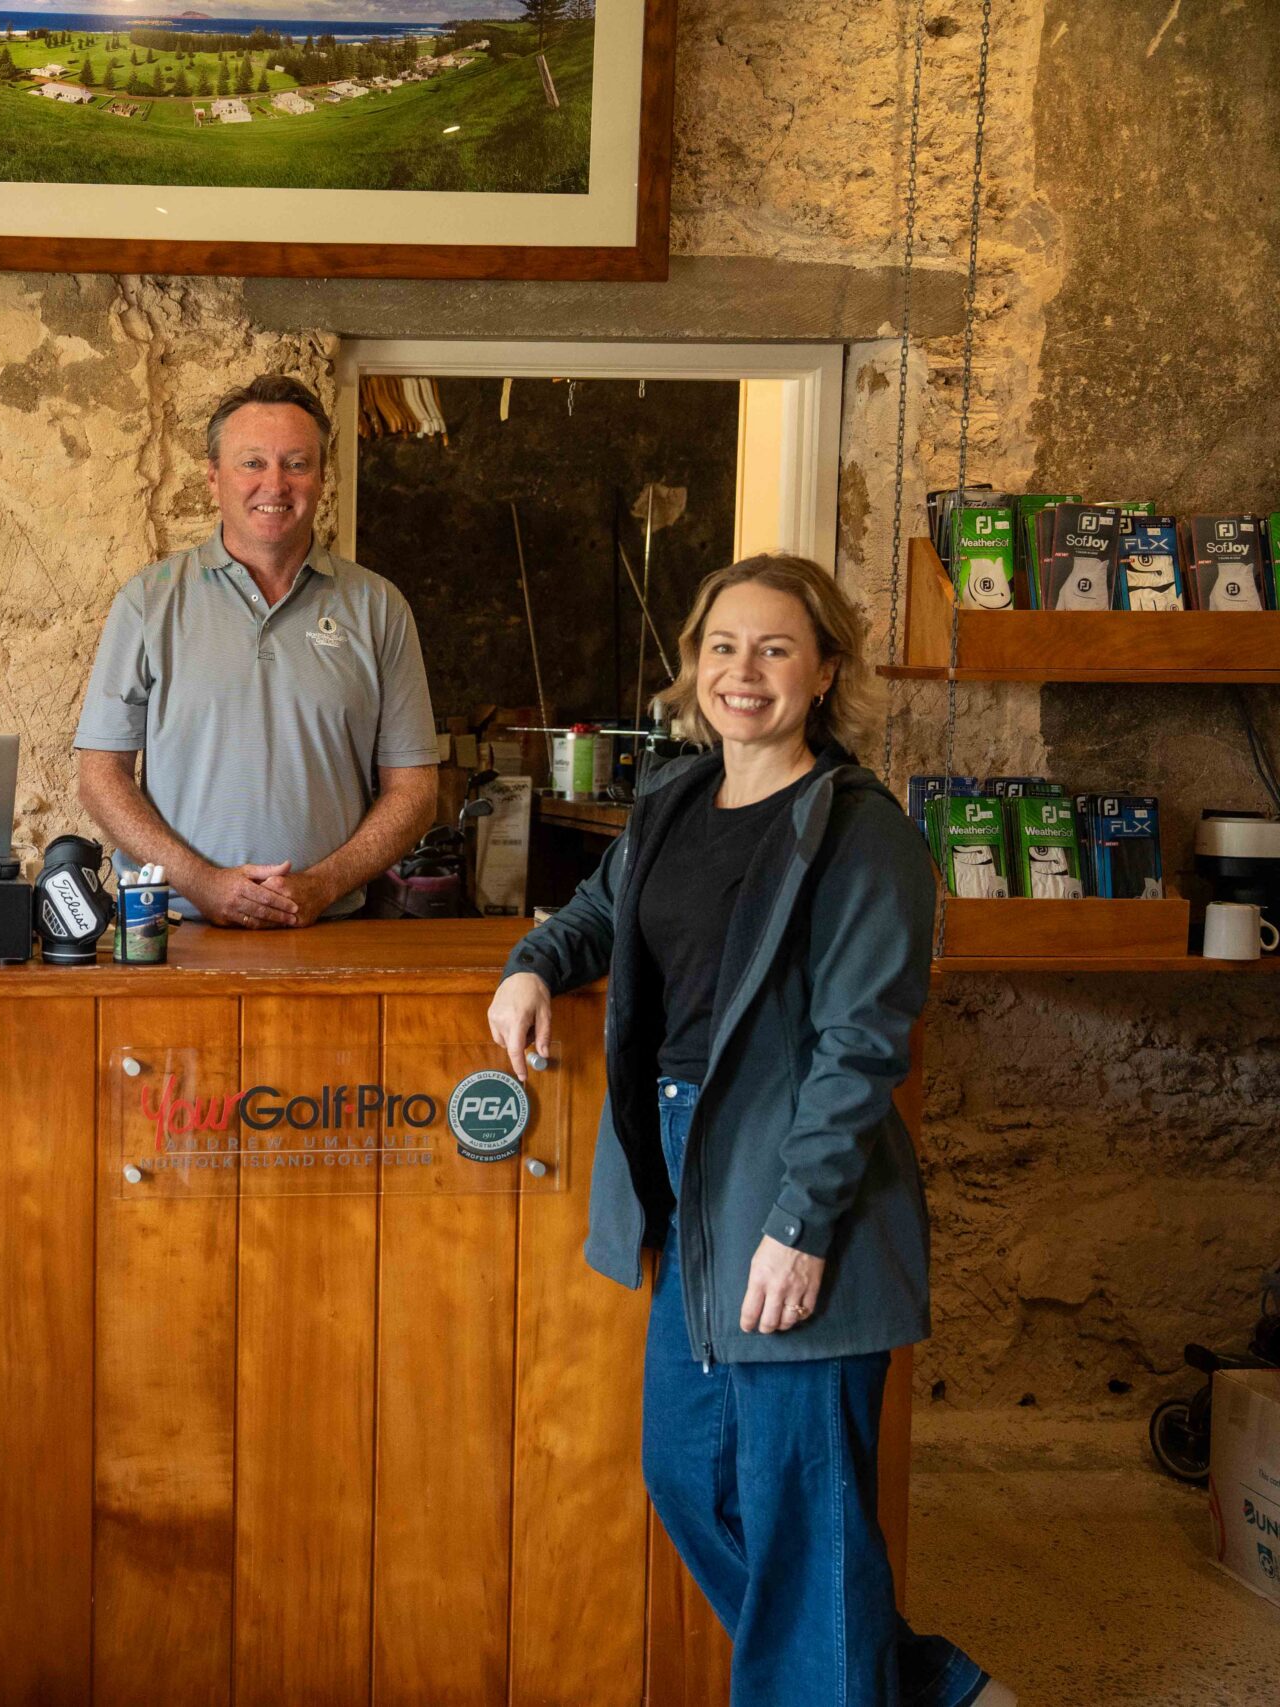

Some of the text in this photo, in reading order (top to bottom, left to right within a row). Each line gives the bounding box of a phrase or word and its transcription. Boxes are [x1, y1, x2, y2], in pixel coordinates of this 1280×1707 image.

[975, 515, 992, 535] FJ
[1081, 515, 1097, 531] FJ
[1218, 523, 1234, 537] FJ
[1065, 534, 1110, 551] SofJoy
[1124, 538, 1169, 550] FLX
[1206, 542, 1250, 555] SofJoy
[982, 580, 992, 589] FJ
[1079, 580, 1090, 591] FJ
[1227, 584, 1239, 594] FJ
[965, 803, 982, 823] FJ
[1041, 805, 1058, 824] FJ
[1103, 798, 1119, 816] FJ
[949, 825, 999, 836] WeatherSof
[1025, 826, 1074, 838] WeatherSof
[1110, 820, 1152, 833] FLX
[51, 879, 89, 930] Titleist
[450, 1072, 527, 1129] PROFESSIONAL GOLFERS ASSOCIATION
[459, 1096, 518, 1120] PGA
[141, 1073, 246, 1151] Your
[166, 1137, 282, 1150] ANDREW
[469, 1139, 509, 1149] AUSTRALIA
[140, 1152, 432, 1169] NORFOLK ISLAND GOLF CLUB
[461, 1149, 516, 1161] PROFESSIONAL
[1243, 1498, 1280, 1538] BUN
